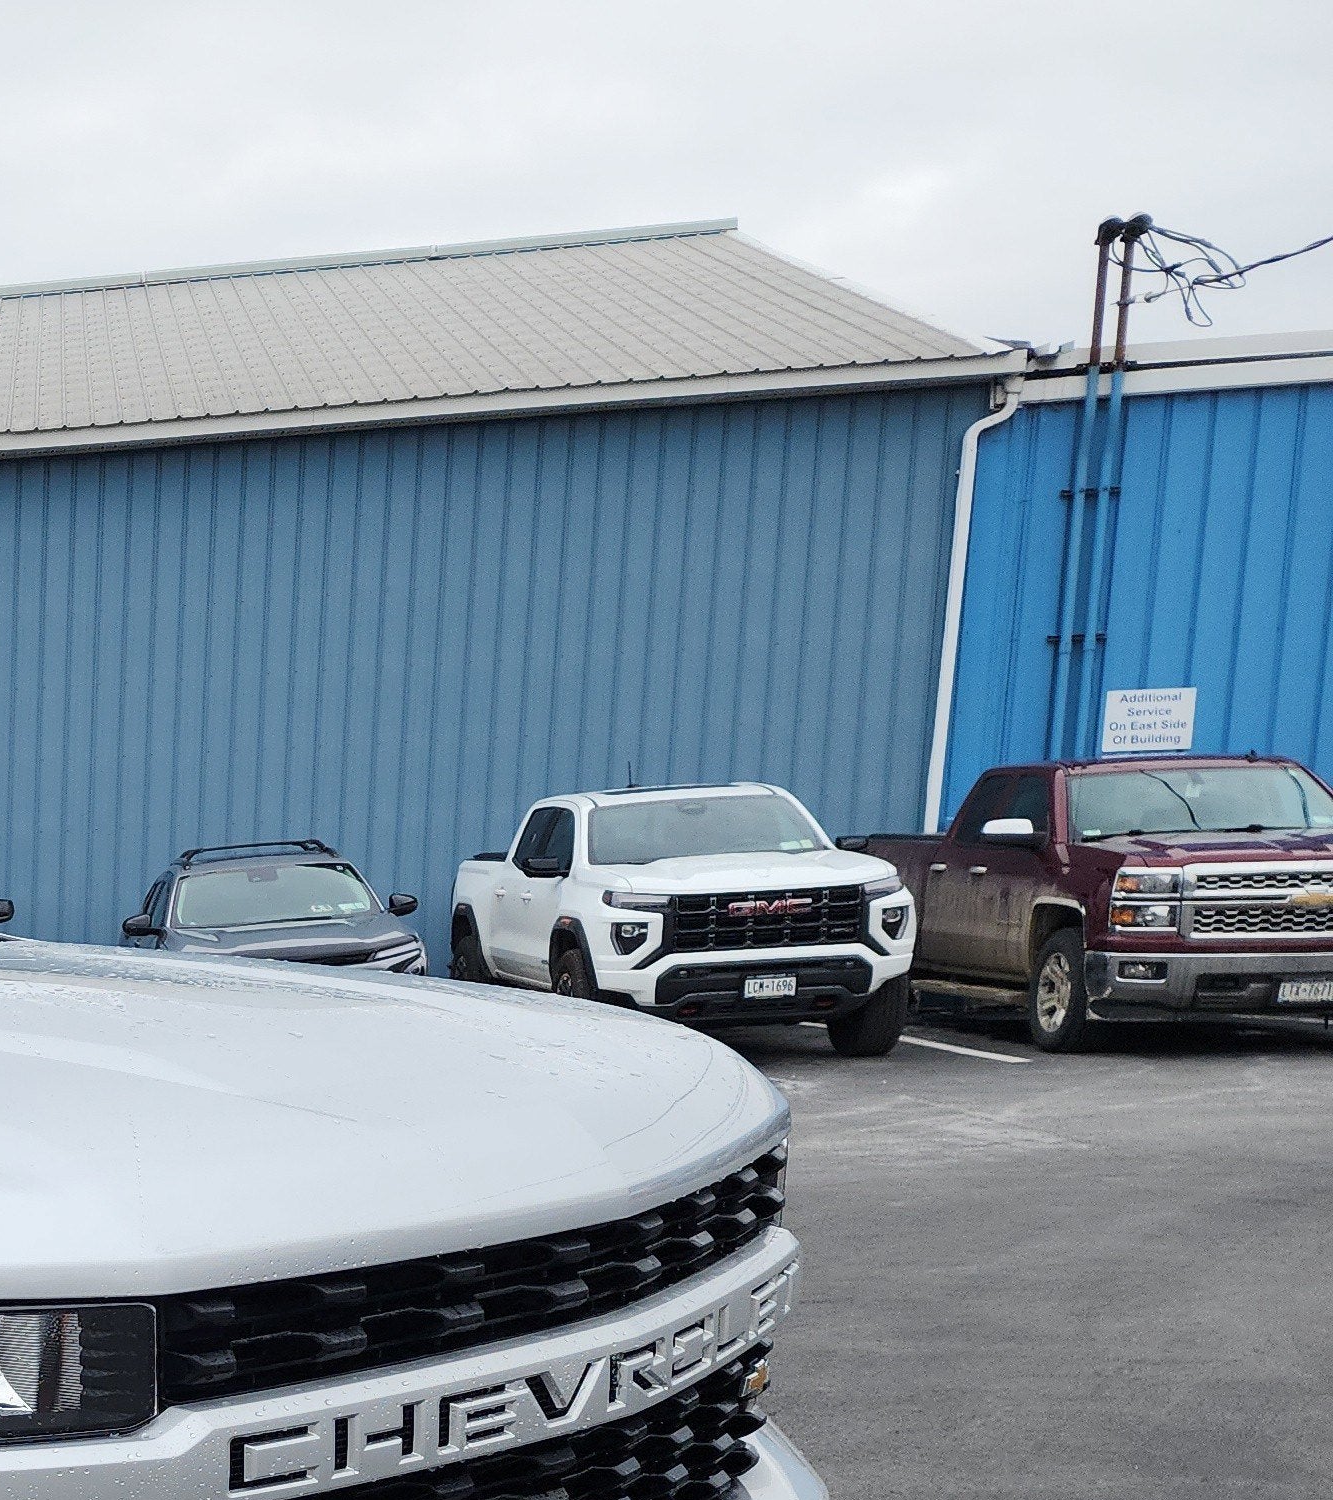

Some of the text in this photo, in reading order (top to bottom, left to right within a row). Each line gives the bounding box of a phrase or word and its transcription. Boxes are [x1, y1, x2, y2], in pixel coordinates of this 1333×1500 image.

[1120, 692, 1182, 704] Additional
[1127, 707, 1172, 717] Service
[1109, 719, 1188, 731] On East Side
[1113, 734, 1181, 745] Of Building
[727, 898, 813, 916] GMC
[228, 1262, 800, 1498] CHEVROLET
